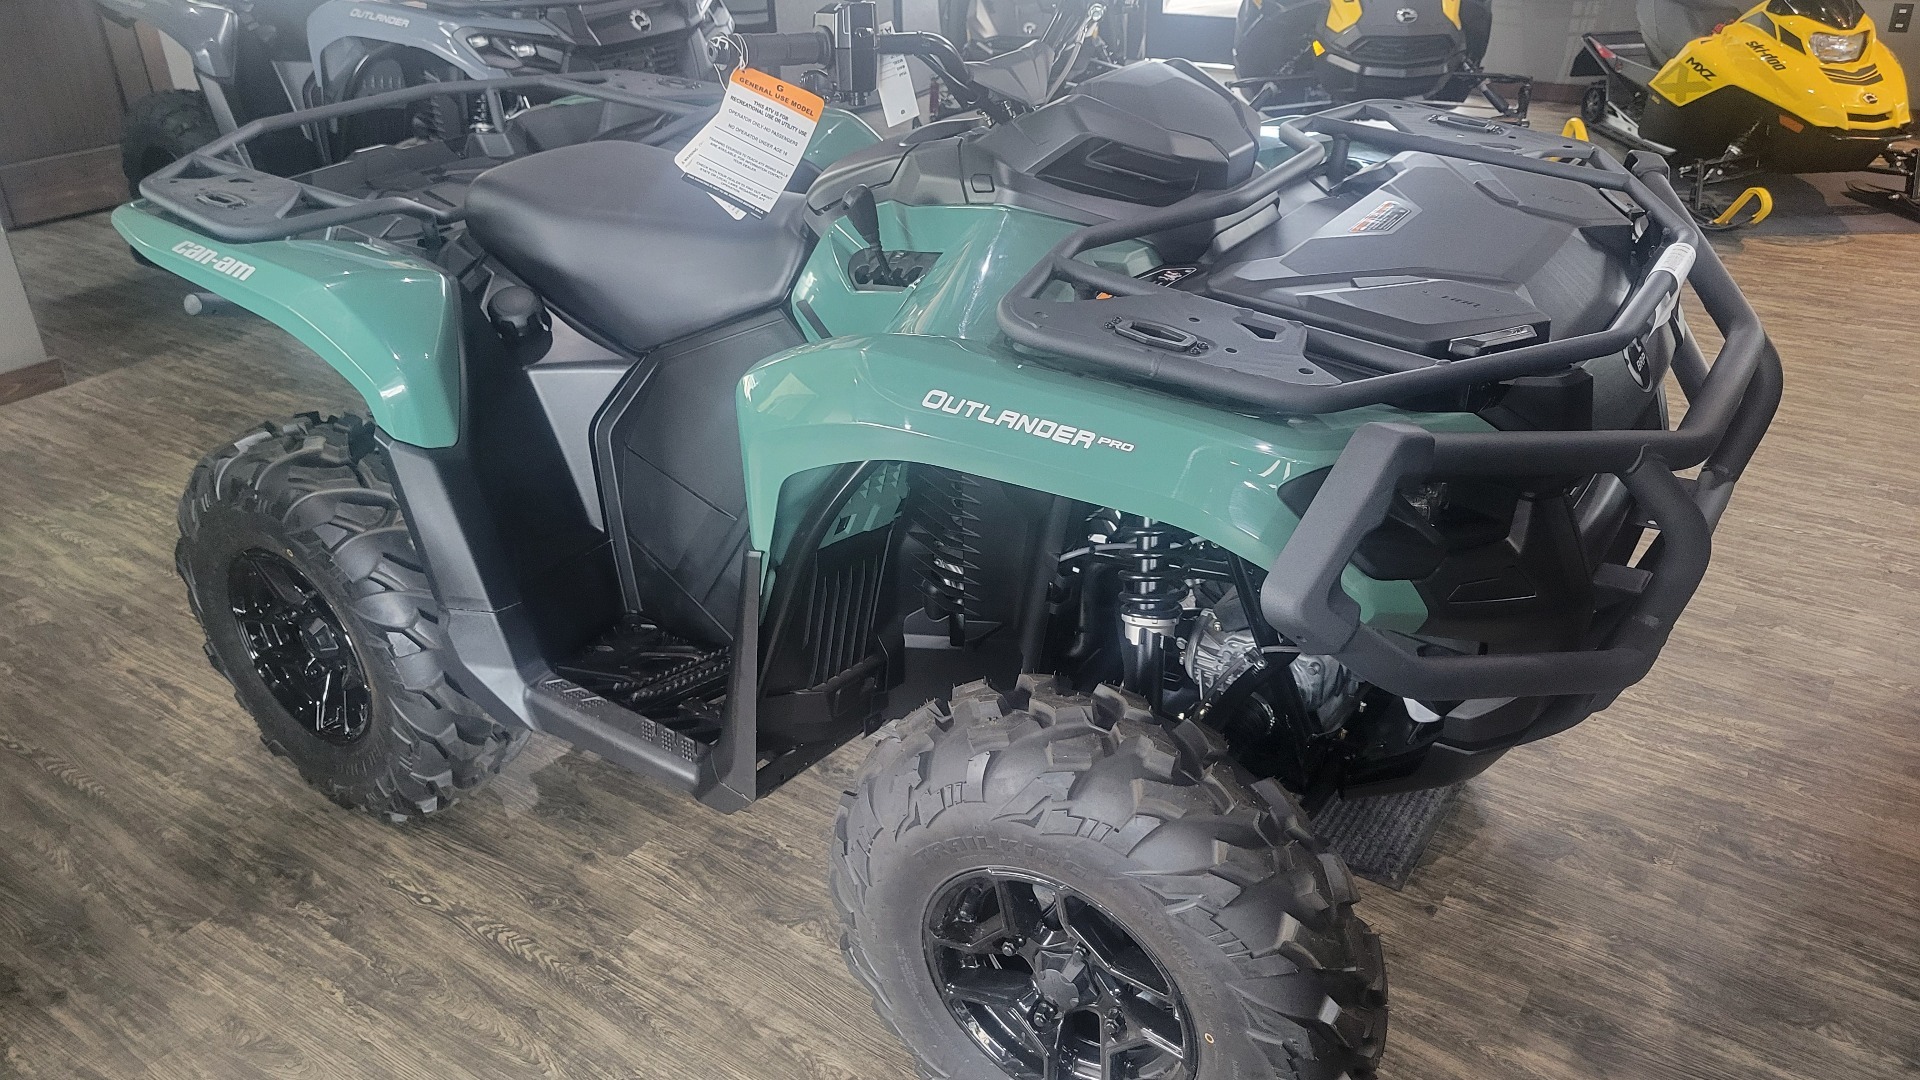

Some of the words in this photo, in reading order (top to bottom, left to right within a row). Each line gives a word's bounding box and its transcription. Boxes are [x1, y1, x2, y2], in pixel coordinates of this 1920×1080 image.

[350, 8, 410, 28] OUTLANDER
[1686, 57, 1717, 82] MXZ
[1745, 40, 1786, 71] ski-doo
[738, 76, 773, 96] GENERAL
[774, 92, 789, 103] USE
[790, 100, 815, 115] MODEL
[776, 84, 784, 92] G
[728, 108, 752, 122] OPERATOR
[770, 130, 798, 146] PASSENGERS
[729, 95, 764, 114] RECREATIONAL
[781, 121, 797, 132] UTILITY
[734, 127, 758, 141] OPERATOR
[758, 139, 773, 148] UNDER
[172, 241, 256, 281] can-am
[1636, 352, 1646, 372] BRP
[922, 389, 1096, 449] OUTLANDER
[1097, 436, 1135, 453] PRO
[913, 835, 994, 864] TRAIL
[999, 837, 1090, 879] KING
